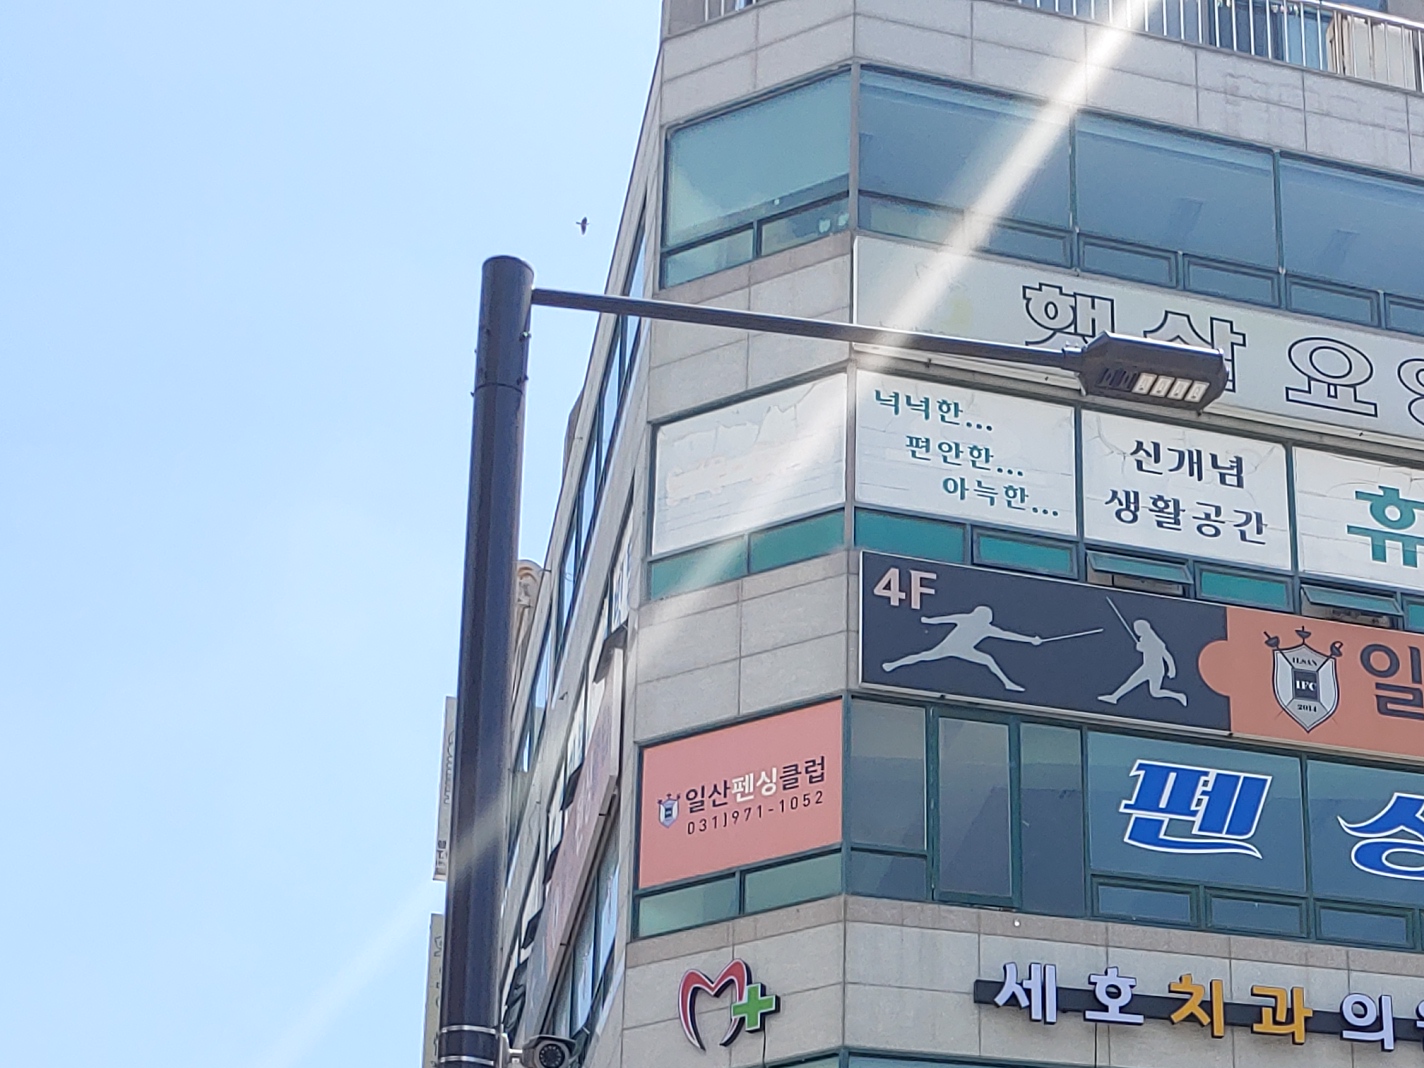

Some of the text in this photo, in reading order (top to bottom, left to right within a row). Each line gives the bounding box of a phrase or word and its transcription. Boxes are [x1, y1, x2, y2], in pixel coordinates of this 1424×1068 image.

[1130, 440, 1245, 490] 신개념
[1105, 488, 1268, 545] 생활공간
[873, 566, 936, 610] 4F
[1295, 680, 1317, 691] IFC
[1297, 704, 1317, 713] 2014
[684, 755, 827, 815] 일산펜싱클럽
[685, 789, 825, 836] 031)971-1052
